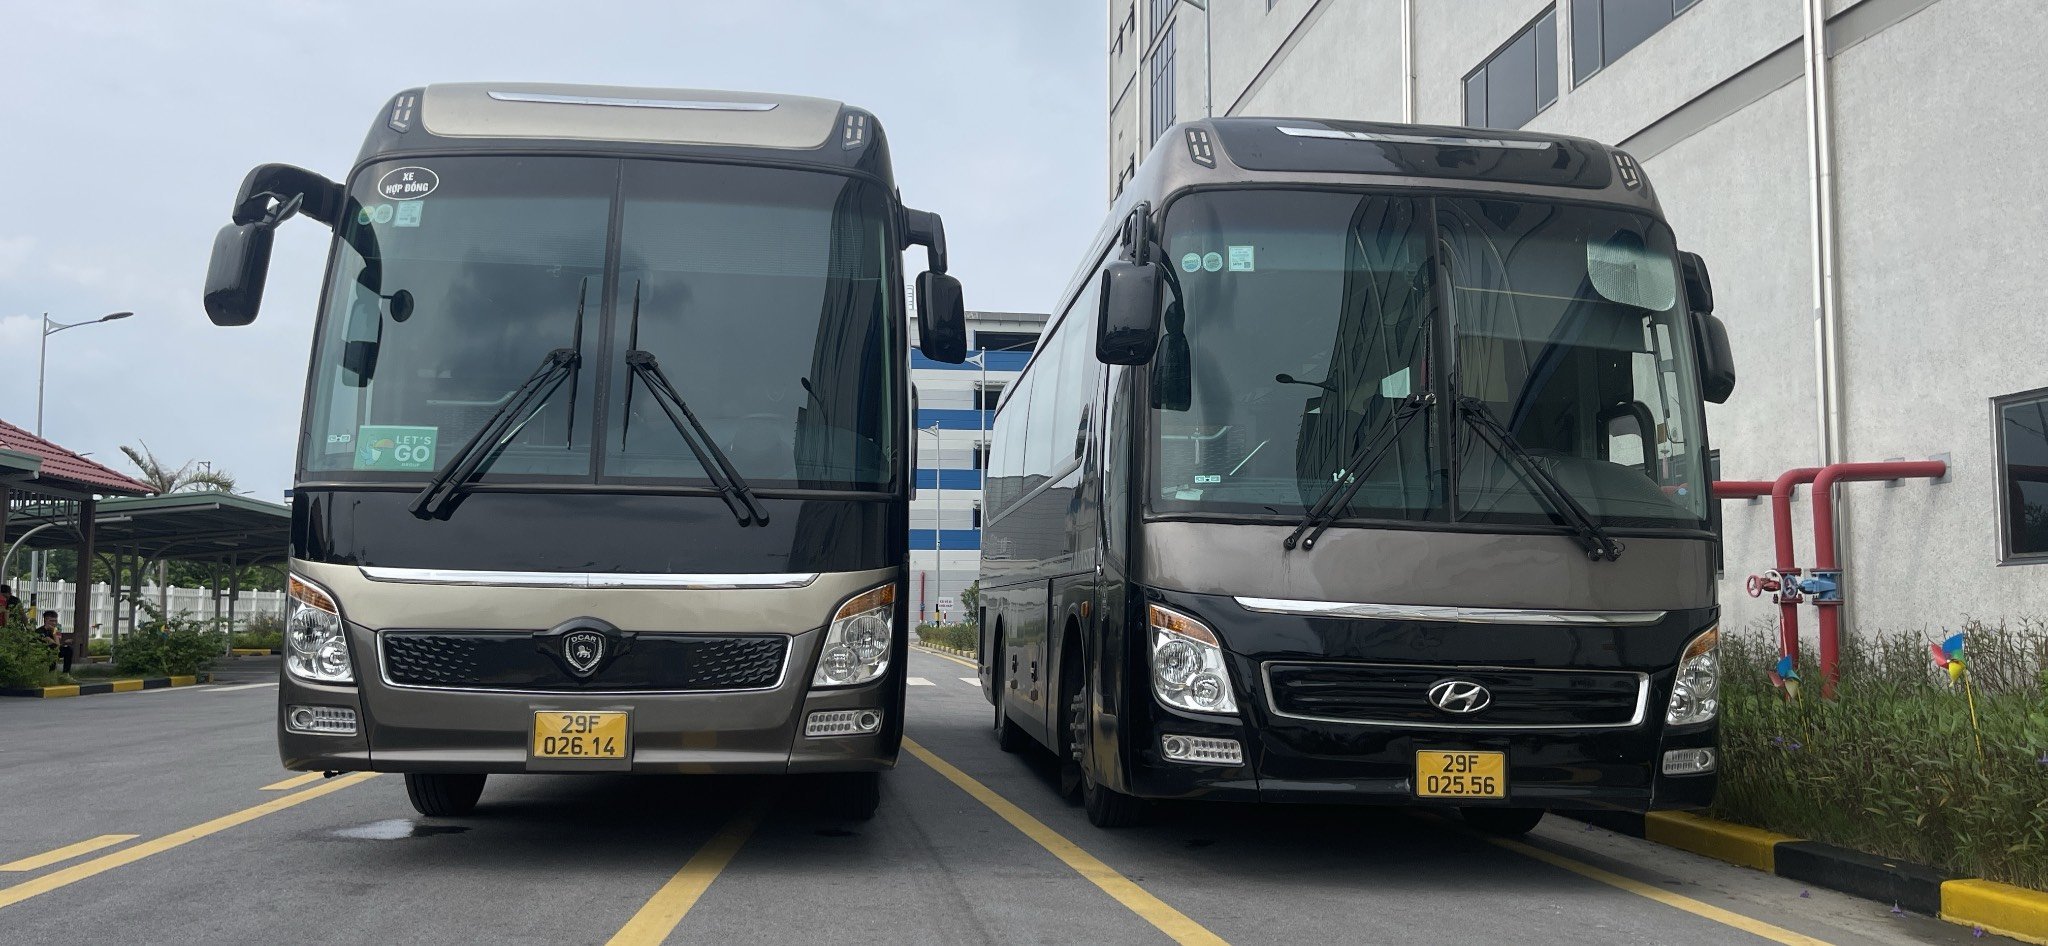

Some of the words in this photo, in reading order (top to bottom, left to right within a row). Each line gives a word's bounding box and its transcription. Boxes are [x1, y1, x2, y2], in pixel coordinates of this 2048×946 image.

[403, 172, 415, 181] XE
[396, 435, 432, 445] LET'S
[394, 444, 430, 463] GO
[570, 634, 597, 643] DCAR
[561, 715, 601, 734] 29F
[544, 736, 615, 756] 026.14
[1442, 754, 1479, 773] 29F
[1427, 775, 1495, 795] 025.56
